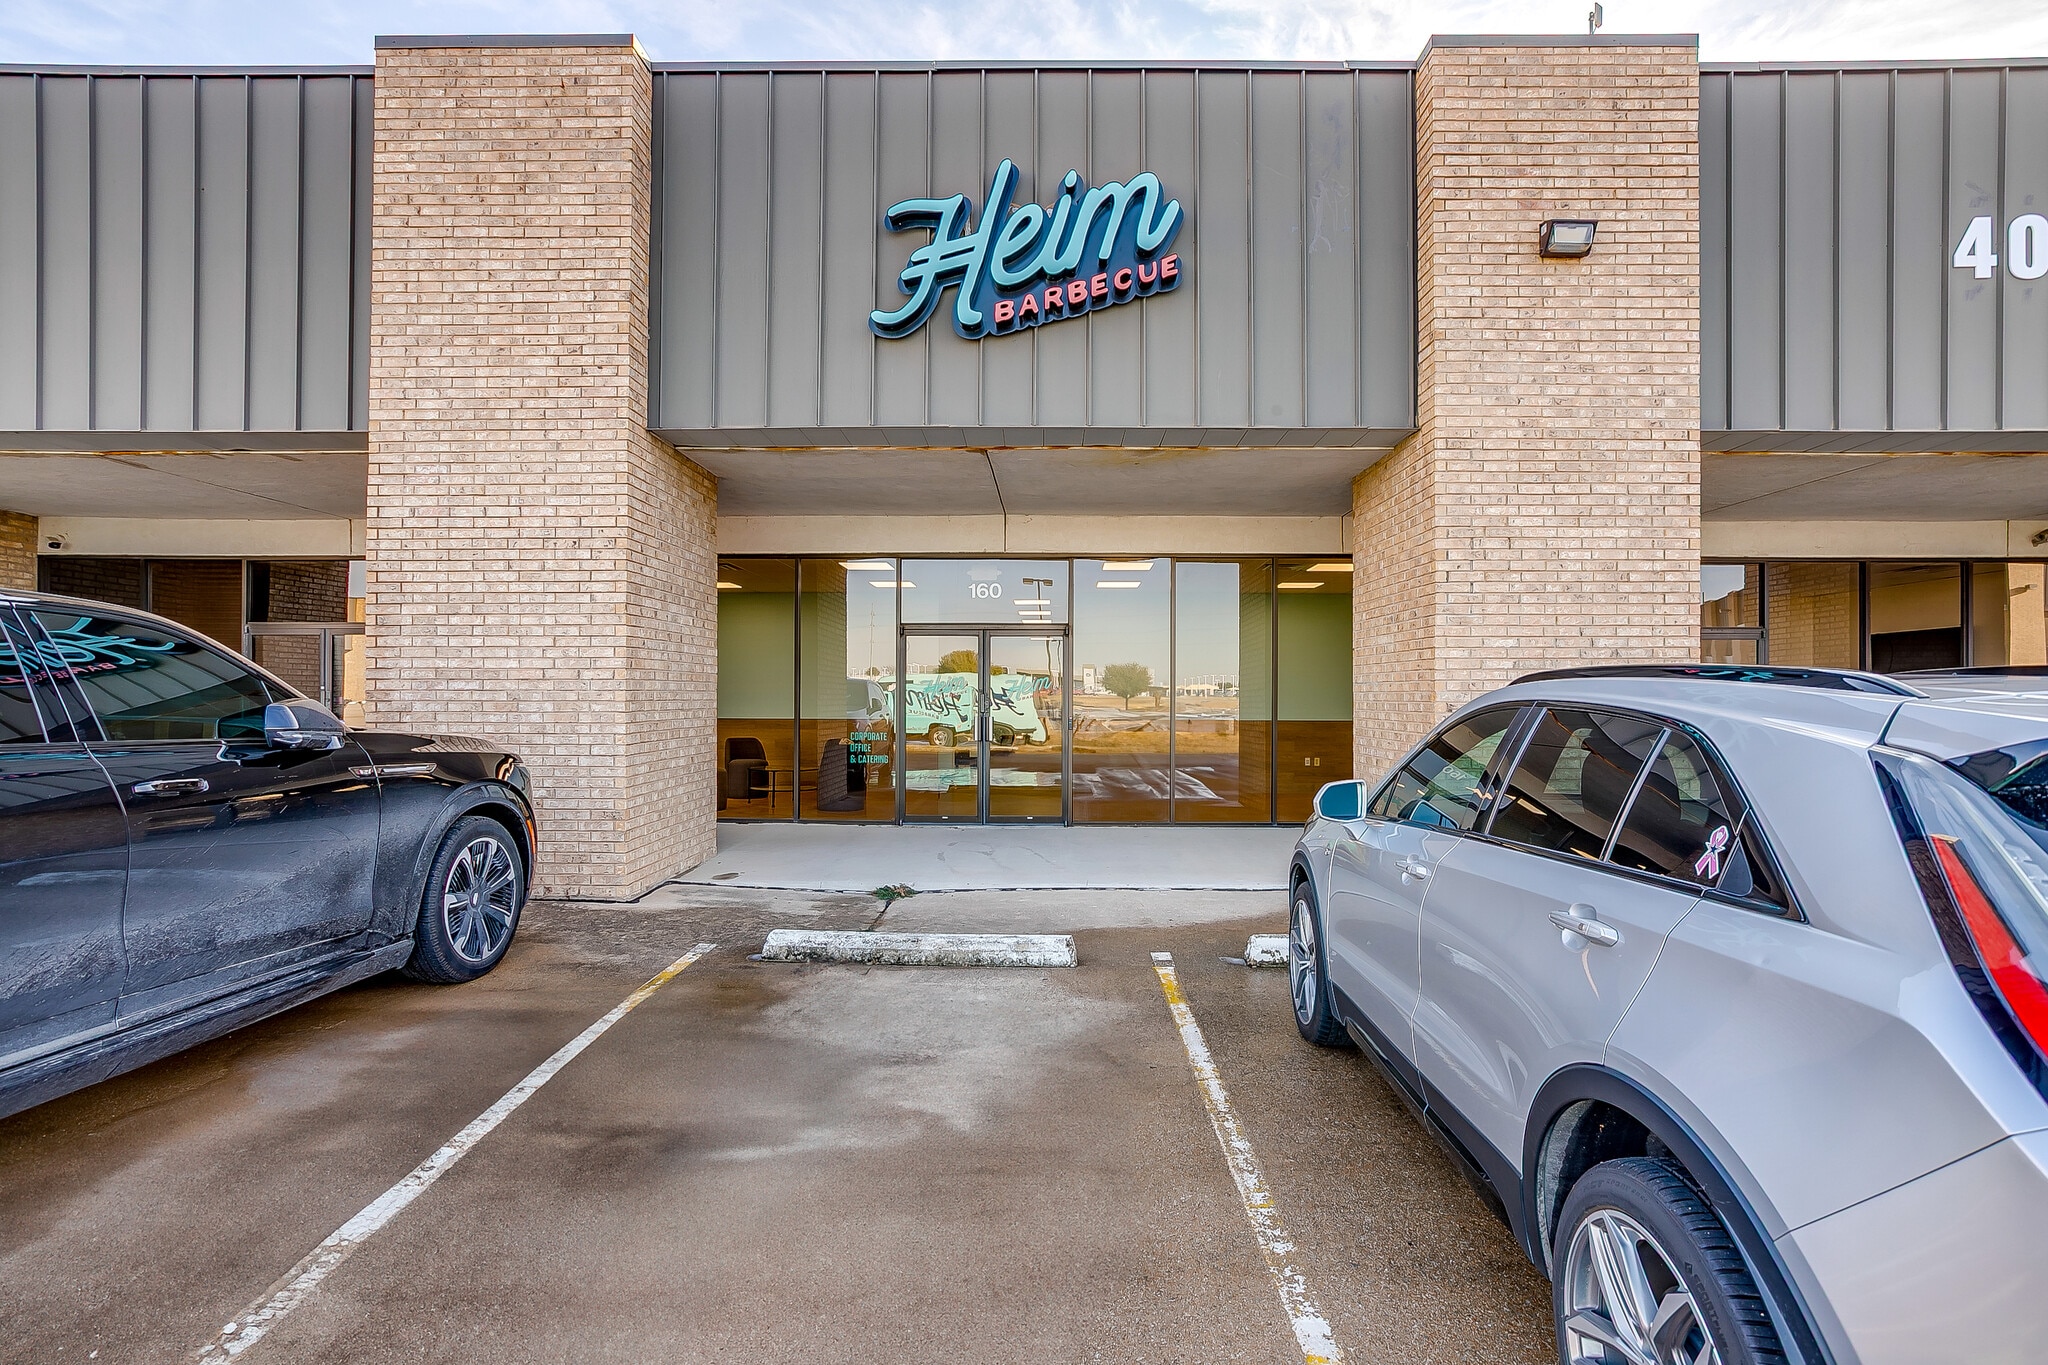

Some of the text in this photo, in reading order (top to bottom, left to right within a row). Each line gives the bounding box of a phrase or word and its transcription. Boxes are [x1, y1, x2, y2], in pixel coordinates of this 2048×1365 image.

[870, 158, 1181, 327] Heim
[1952, 215, 2048, 280] 40
[994, 254, 1179, 323] BARBECUE
[968, 583, 1002, 599] 160
[920, 675, 968, 701] Heim
[1005, 675, 1053, 701] Heim
[850, 732, 887, 740] CORPORATE
[850, 744, 871, 752] OFFICE
[850, 755, 889, 763] & CATERING
